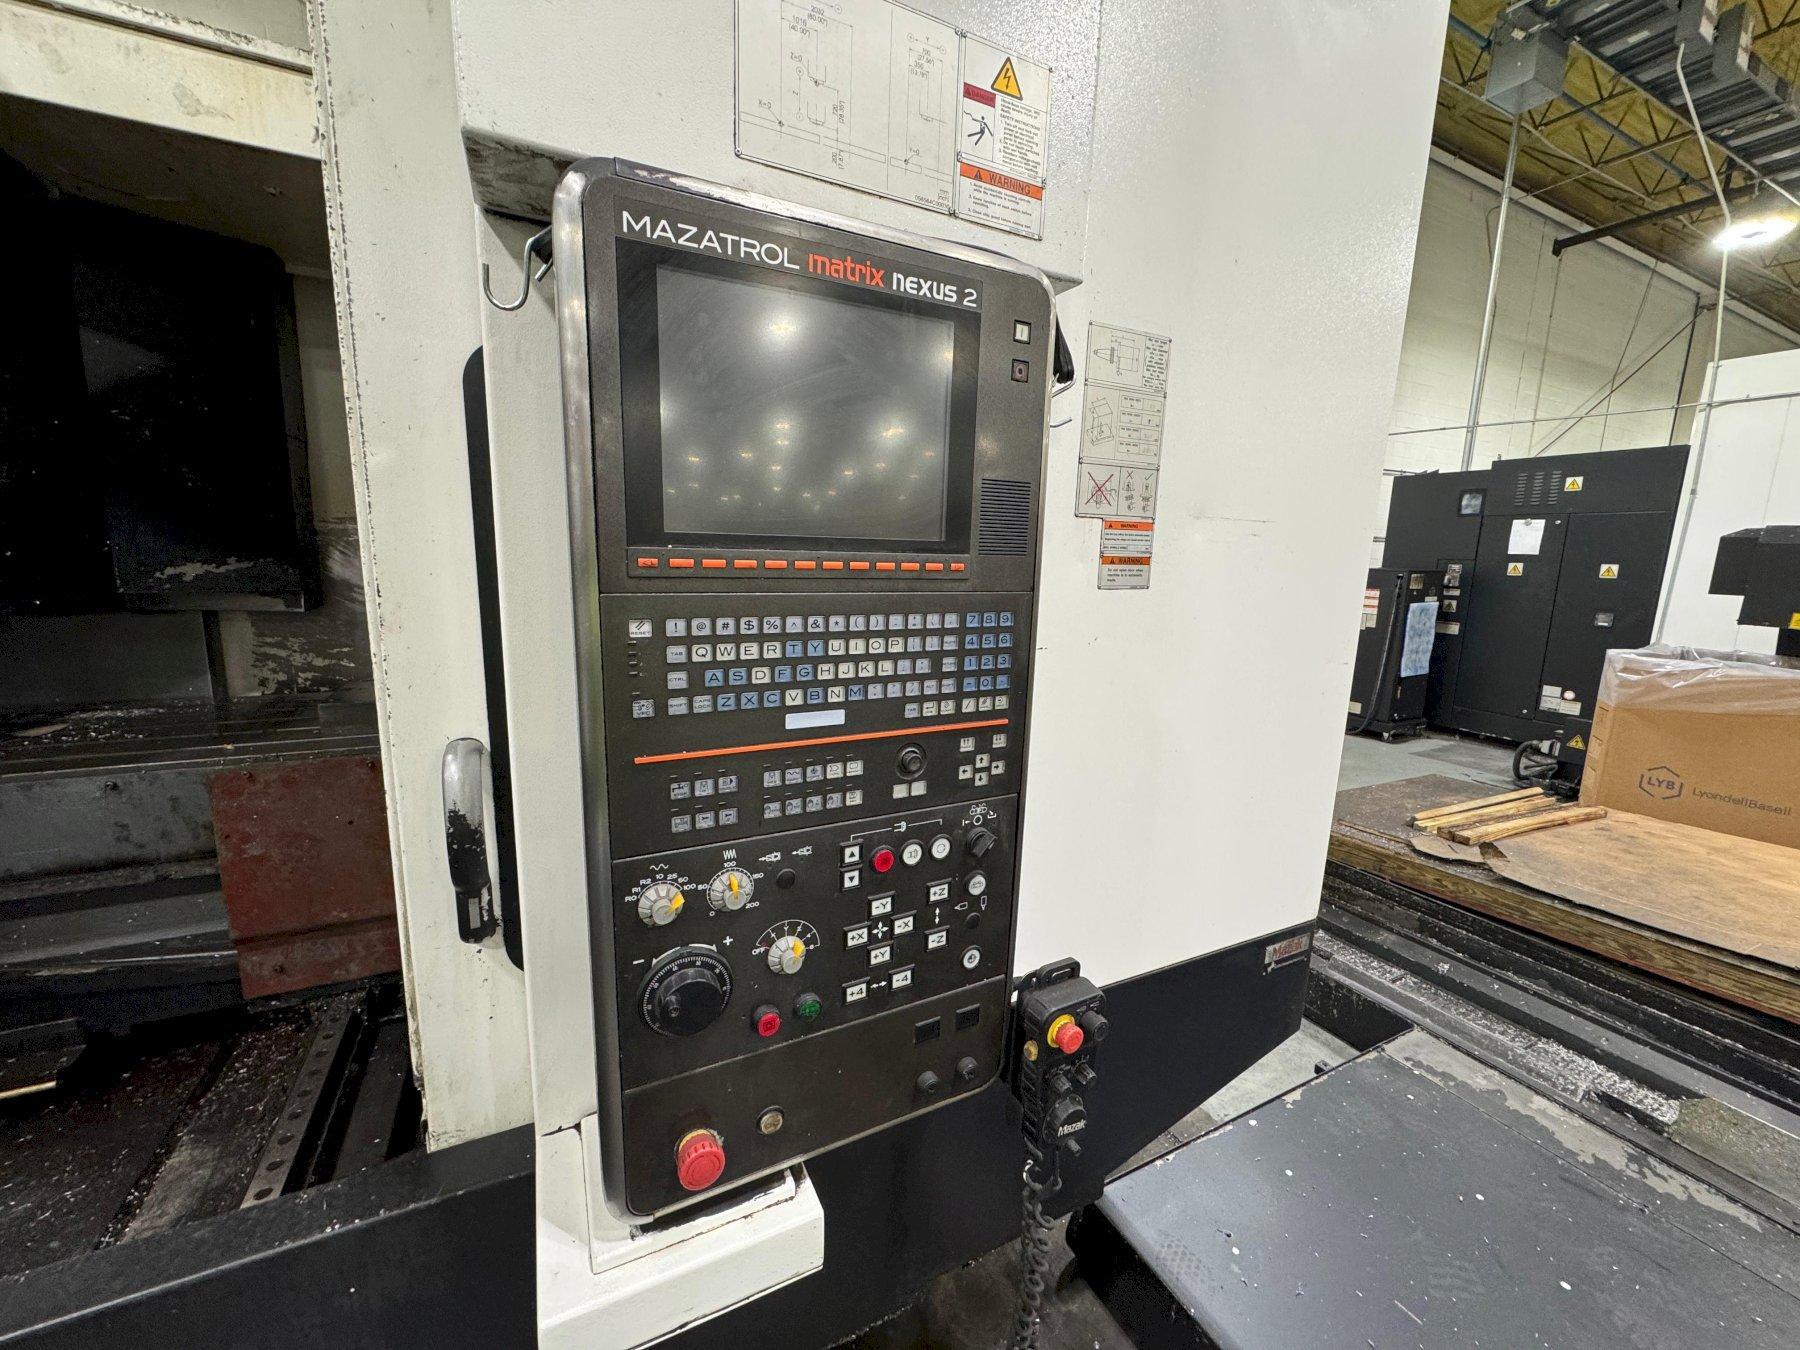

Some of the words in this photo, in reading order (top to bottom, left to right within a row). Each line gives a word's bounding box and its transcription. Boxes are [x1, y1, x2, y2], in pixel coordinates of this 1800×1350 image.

[989, 174, 1031, 195] WARNING
[622, 210, 800, 270] MAZATROL
[808, 253, 886, 288] matrix
[963, 288, 978, 308] 2
[696, 622, 707, 632] @
[721, 622, 730, 631] #
[744, 619, 755, 631] $
[765, 620, 779, 631] %
[811, 619, 821, 629] &
[968, 615, 976, 624] 7
[985, 615, 993, 624] 8
[1002, 615, 1010, 623] 9
[695, 647, 709, 658] Q
[718, 646, 733, 657] W
[744, 645, 754, 656] E
[766, 645, 778, 655] R
[789, 644, 799, 654] T
[810, 642, 821, 653] Y
[831, 643, 842, 652] U
[871, 641, 882, 651] O
[890, 640, 900, 649] P
[967, 637, 975, 646] 4
[984, 636, 992, 645] 5
[1000, 636, 1008, 644] 6
[708, 673, 721, 683] A
[733, 671, 744, 681] S
[755, 670, 767, 680] D
[778, 669, 788, 679] F
[799, 667, 810, 678] G
[821, 667, 831, 675] H
[842, 664, 850, 674] J
[860, 664, 870, 673] K
[881, 664, 889, 672] L
[984, 658, 992, 667] 2
[1000, 656, 1007, 665] 3
[721, 697, 732, 707] Z
[744, 696, 755, 706] X
[767, 694, 777, 704] C
[789, 692, 800, 702] V
[810, 690, 820, 701] B
[830, 690, 841, 699] N
[850, 688, 862, 697] M
[1647, 776, 1675, 791] LYB
[678, 876, 689, 884] 50
[683, 883, 697, 891] 100
[932, 888, 947, 897] +Z
[745, 901, 760, 909] 200
[875, 901, 889, 911] -Y
[897, 920, 911, 929] -X
[850, 932, 865, 942] +X
[930, 935, 945, 944] -Z
[873, 950, 888, 960] +Y
[895, 974, 908, 984] -4
[848, 988, 864, 998] +4
[1057, 1118, 1087, 1137] Mazak
